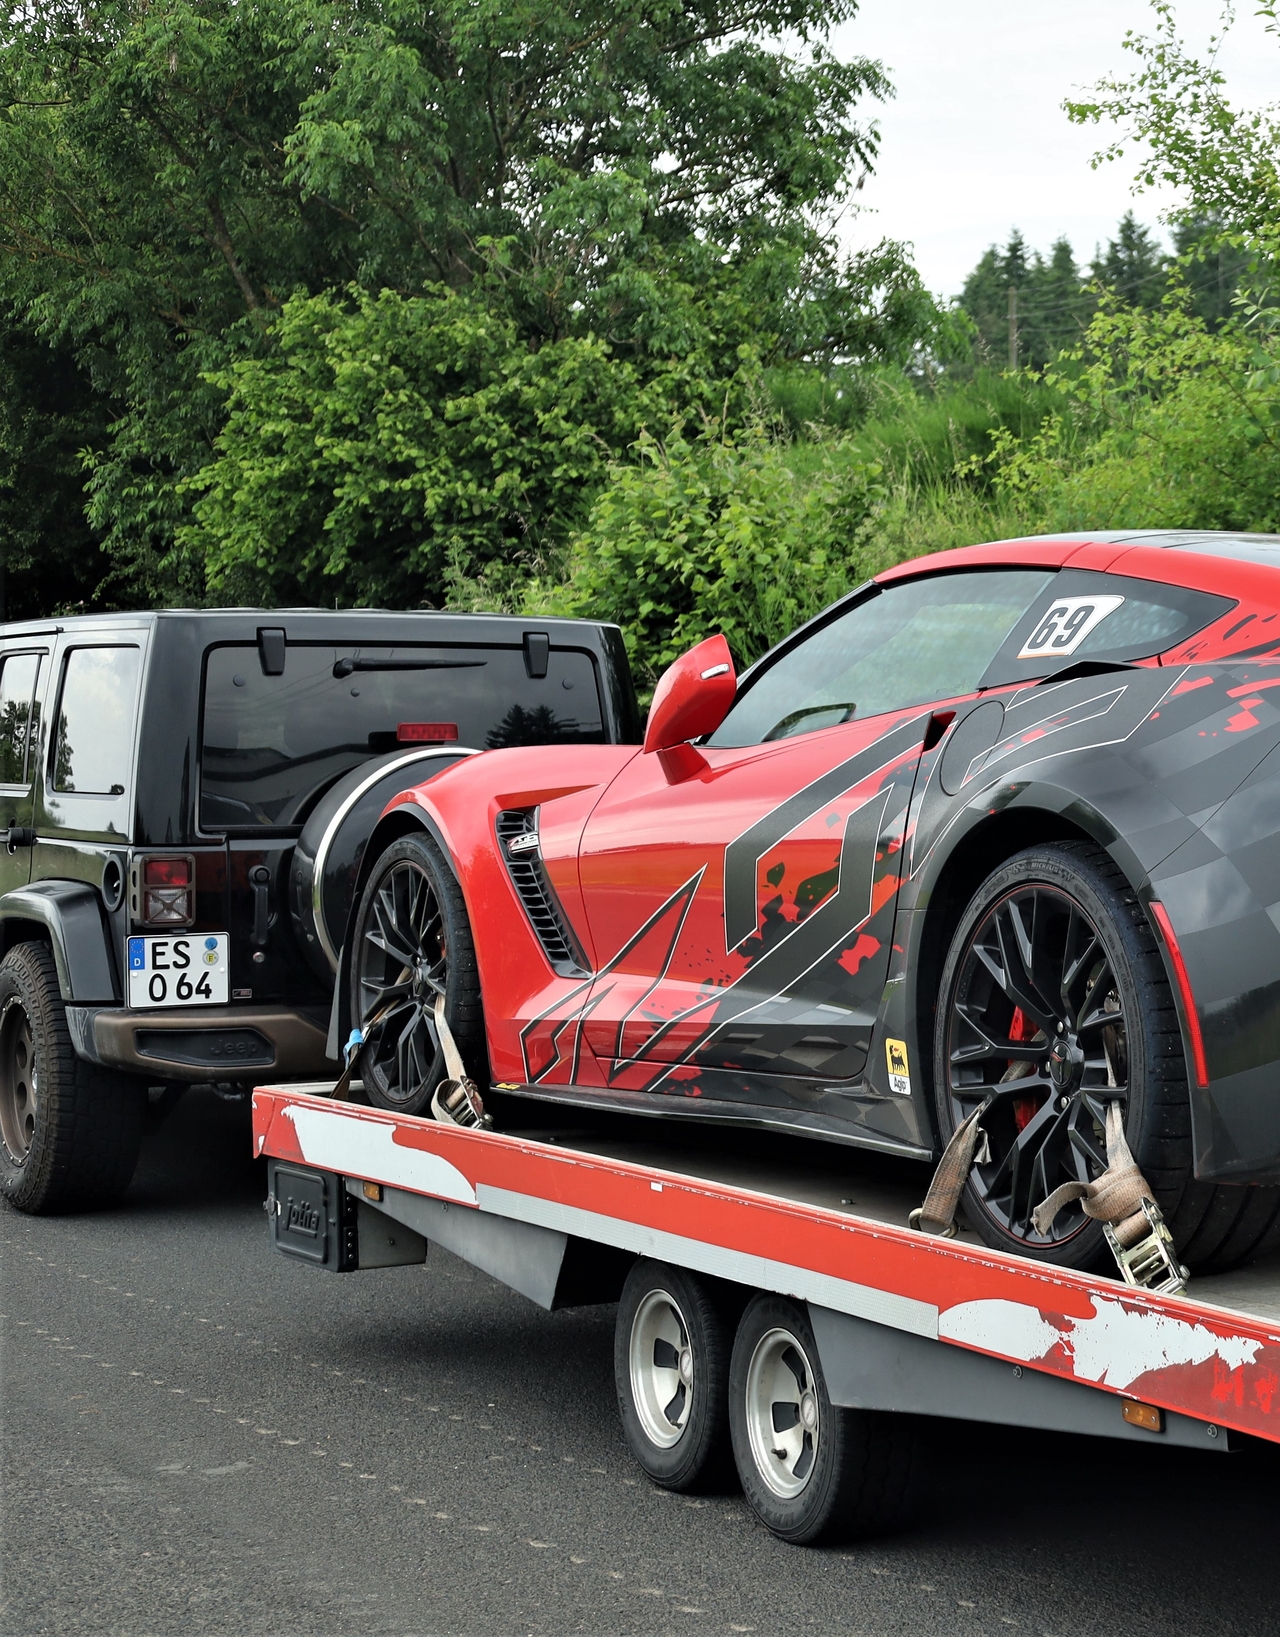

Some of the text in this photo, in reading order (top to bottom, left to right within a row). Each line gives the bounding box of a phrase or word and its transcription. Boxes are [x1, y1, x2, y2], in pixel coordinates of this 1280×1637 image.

[1027, 605, 1095, 650] 69
[134, 957, 141, 967] D
[151, 940, 191, 970] ES
[176, 971, 212, 1000] 64
[210, 1038, 259, 1058] Jeep
[894, 1076, 906, 1092] Agip
